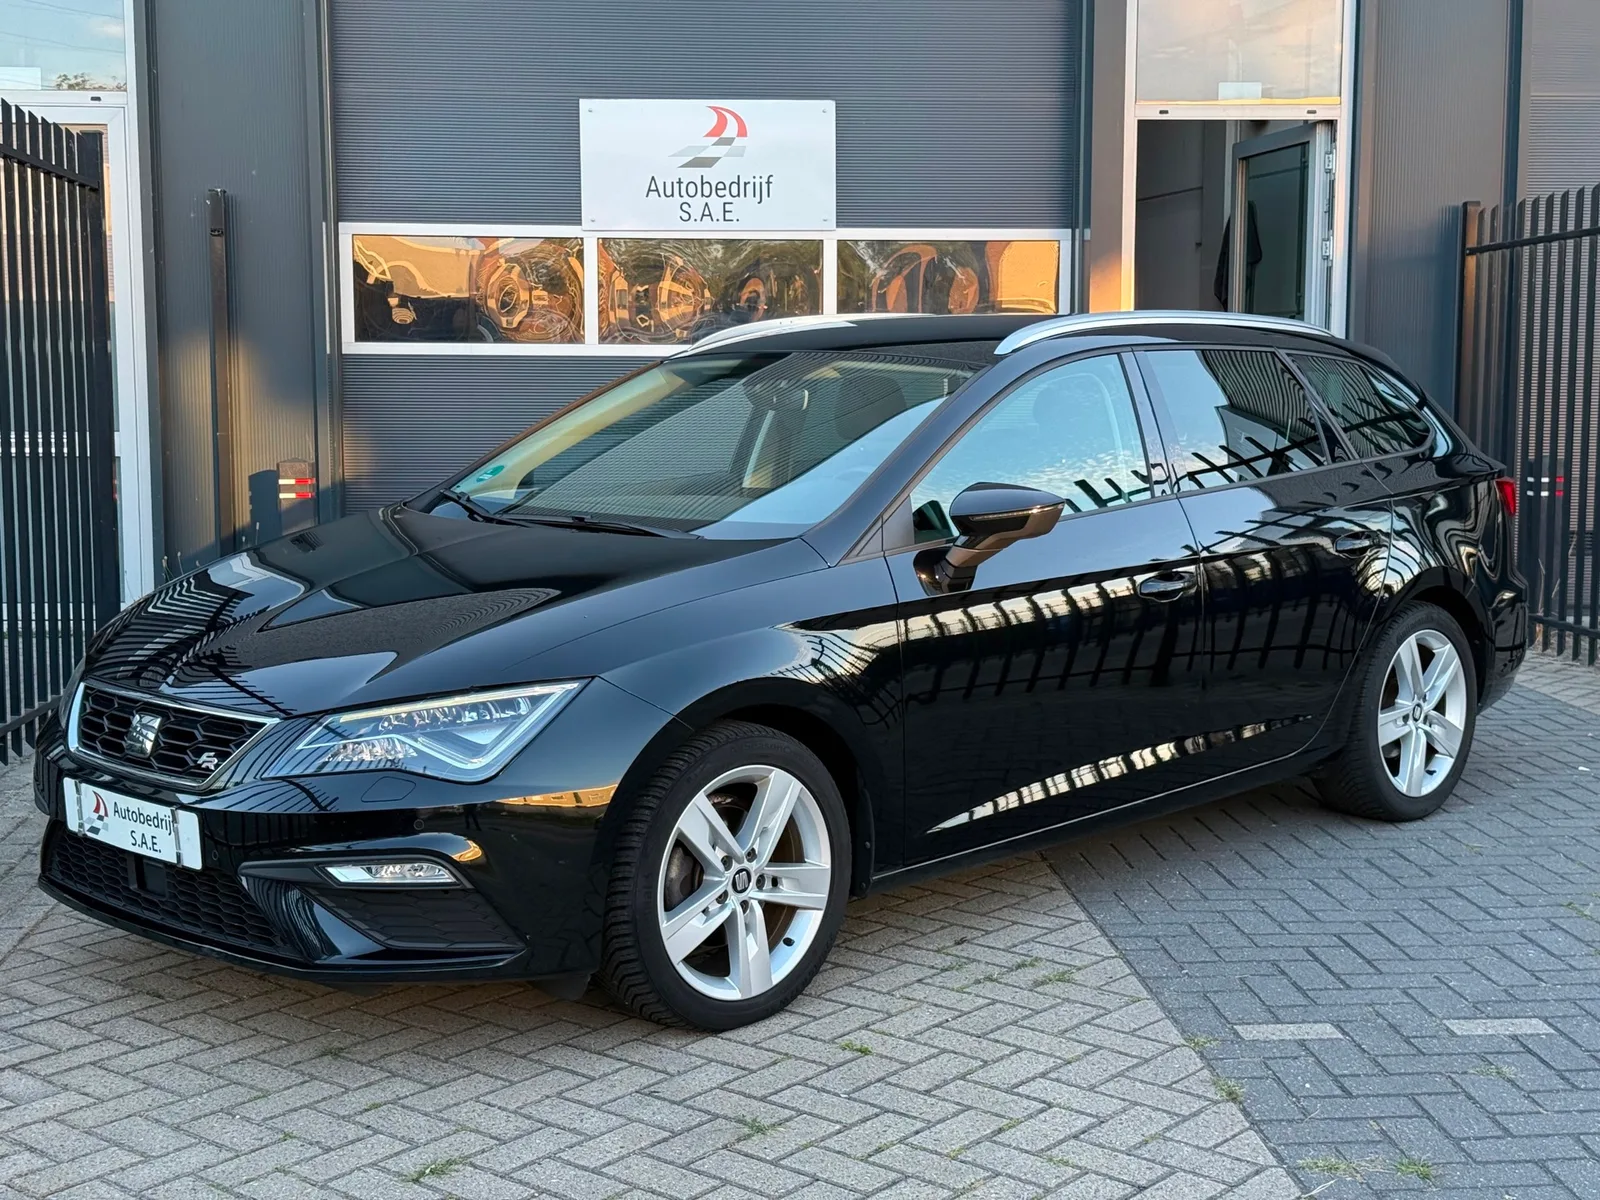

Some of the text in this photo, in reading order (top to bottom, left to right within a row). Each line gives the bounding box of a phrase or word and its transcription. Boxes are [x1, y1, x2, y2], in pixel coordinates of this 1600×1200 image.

[645, 175, 774, 204] Autobedrijf
[679, 202, 740, 222] S.A.E.
[130, 830, 162, 853] S.A.E.
